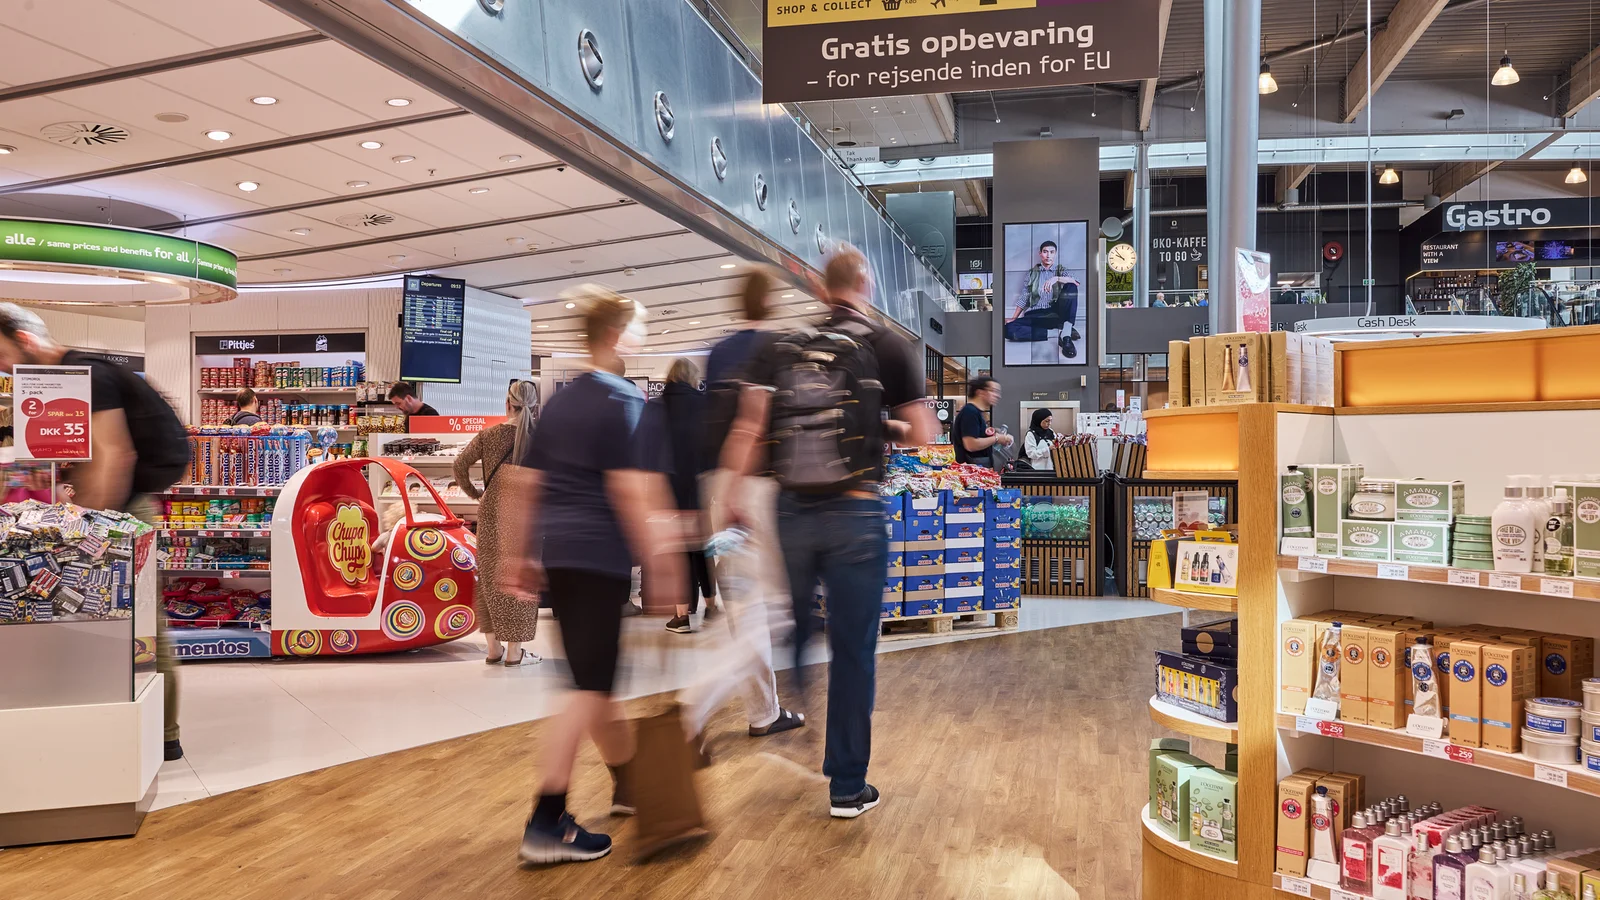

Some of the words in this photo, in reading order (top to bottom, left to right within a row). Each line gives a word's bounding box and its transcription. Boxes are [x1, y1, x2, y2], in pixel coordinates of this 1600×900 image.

[777, 5, 805, 15] SHOP
[811, 4, 818, 12] &
[824, 0, 872, 11] COLLECT
[822, 34, 910, 60] Gratis
[921, 21, 1093, 58] opbevaring
[827, 70, 860, 88] for
[868, 63, 962, 88] rejsende
[970, 58, 1030, 78] inden
[1039, 56, 1075, 73] for
[1084, 51, 1110, 70] EU
[1446, 203, 1551, 228] Gastro
[5, 233, 36, 246] alle
[47, 240, 70, 248] same
[73, 242, 100, 250] prices
[120, 246, 152, 257] benefits
[154, 247, 173, 260] for
[176, 252, 189, 263] all
[1153, 237, 1206, 248] ØKO-KAFFE
[1160, 252, 1171, 261] TO
[1175, 252, 1186, 261] GO
[1358, 317, 1384, 328] Cash
[1389, 316, 1416, 327] Desk
[229, 340, 254, 350] Pittjes
[29, 401, 36, 410] 2
[64, 423, 84, 435] 35
[1403, 488, 1443, 497] AMANDE
[333, 522, 364, 545] Chupa
[1348, 526, 1382, 536] AMANDE
[1400, 529, 1437, 539] AMANDE
[334, 542, 365, 572] Chups
[170, 640, 250, 656] mentos
[1330, 725, 1342, 733] 259
[1459, 750, 1472, 758] 259
